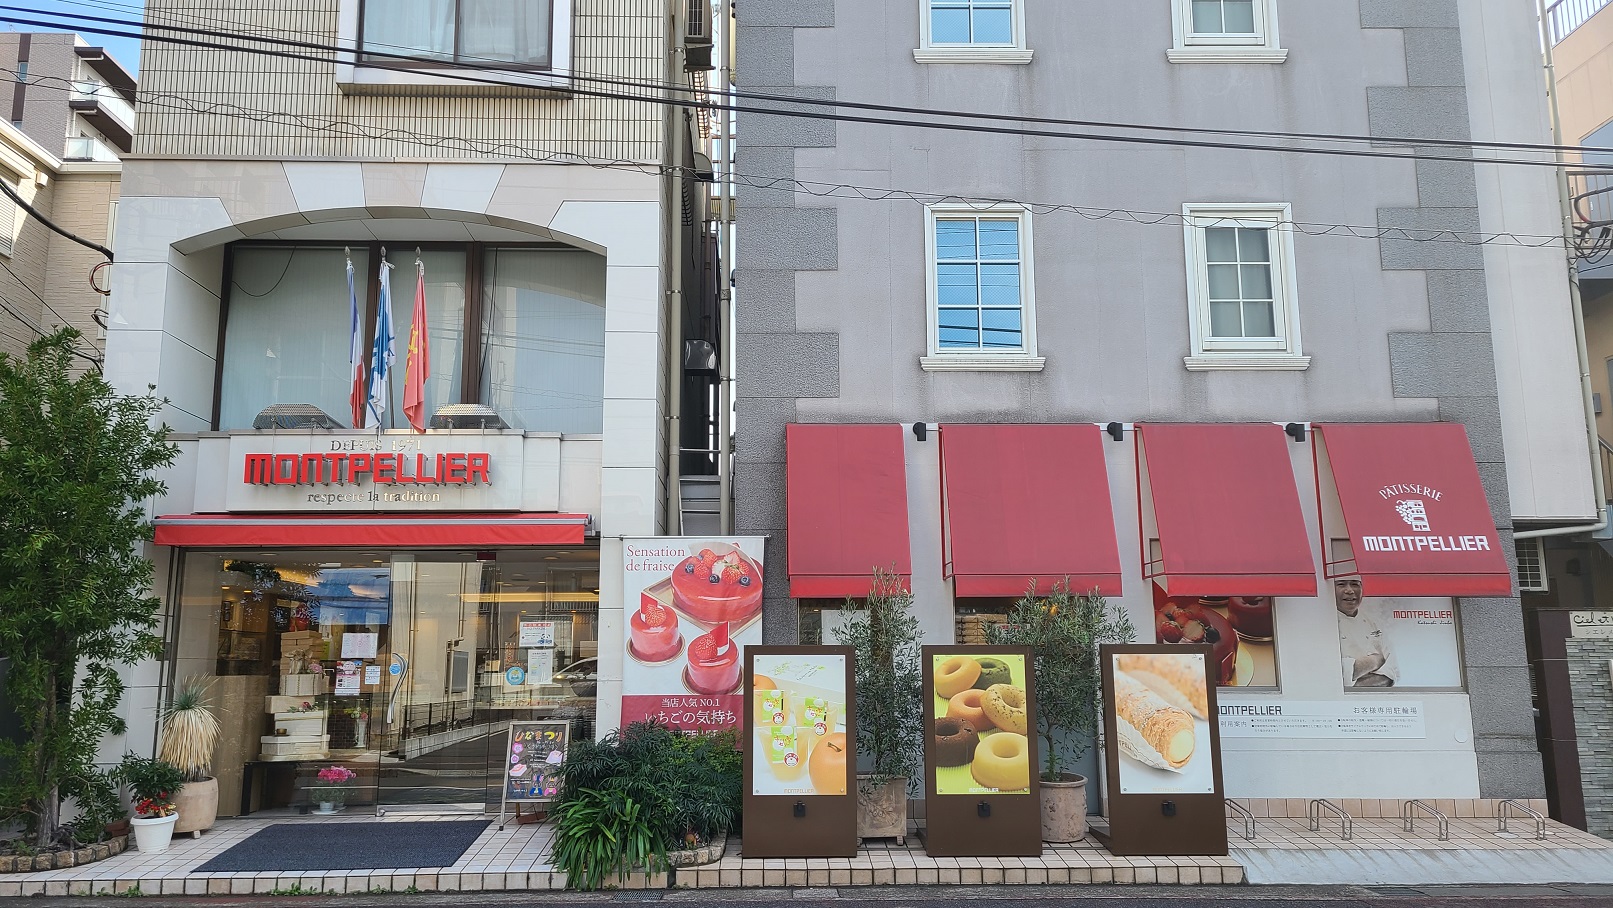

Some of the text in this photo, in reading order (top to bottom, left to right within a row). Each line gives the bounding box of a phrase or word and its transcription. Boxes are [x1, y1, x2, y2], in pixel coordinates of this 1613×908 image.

[331, 439, 421, 452] DEPUIS 1971
[244, 453, 490, 484] MONTPELLIER
[307, 490, 440, 505] respecte la tradition
[1378, 482, 1444, 502] PÂTISSERIE
[1362, 535, 1491, 551] MONTPELLIER
[626, 544, 685, 557] Sensation
[626, 559, 675, 571] de fraise
[1393, 610, 1453, 619] MONTPELLIER
[1573, 611, 1597, 625] Ciel
[661, 697, 720, 708] 当店人気 NO.1
[644, 709, 737, 725] いちごの気持ち
[514, 730, 563, 742] ひなまつり
